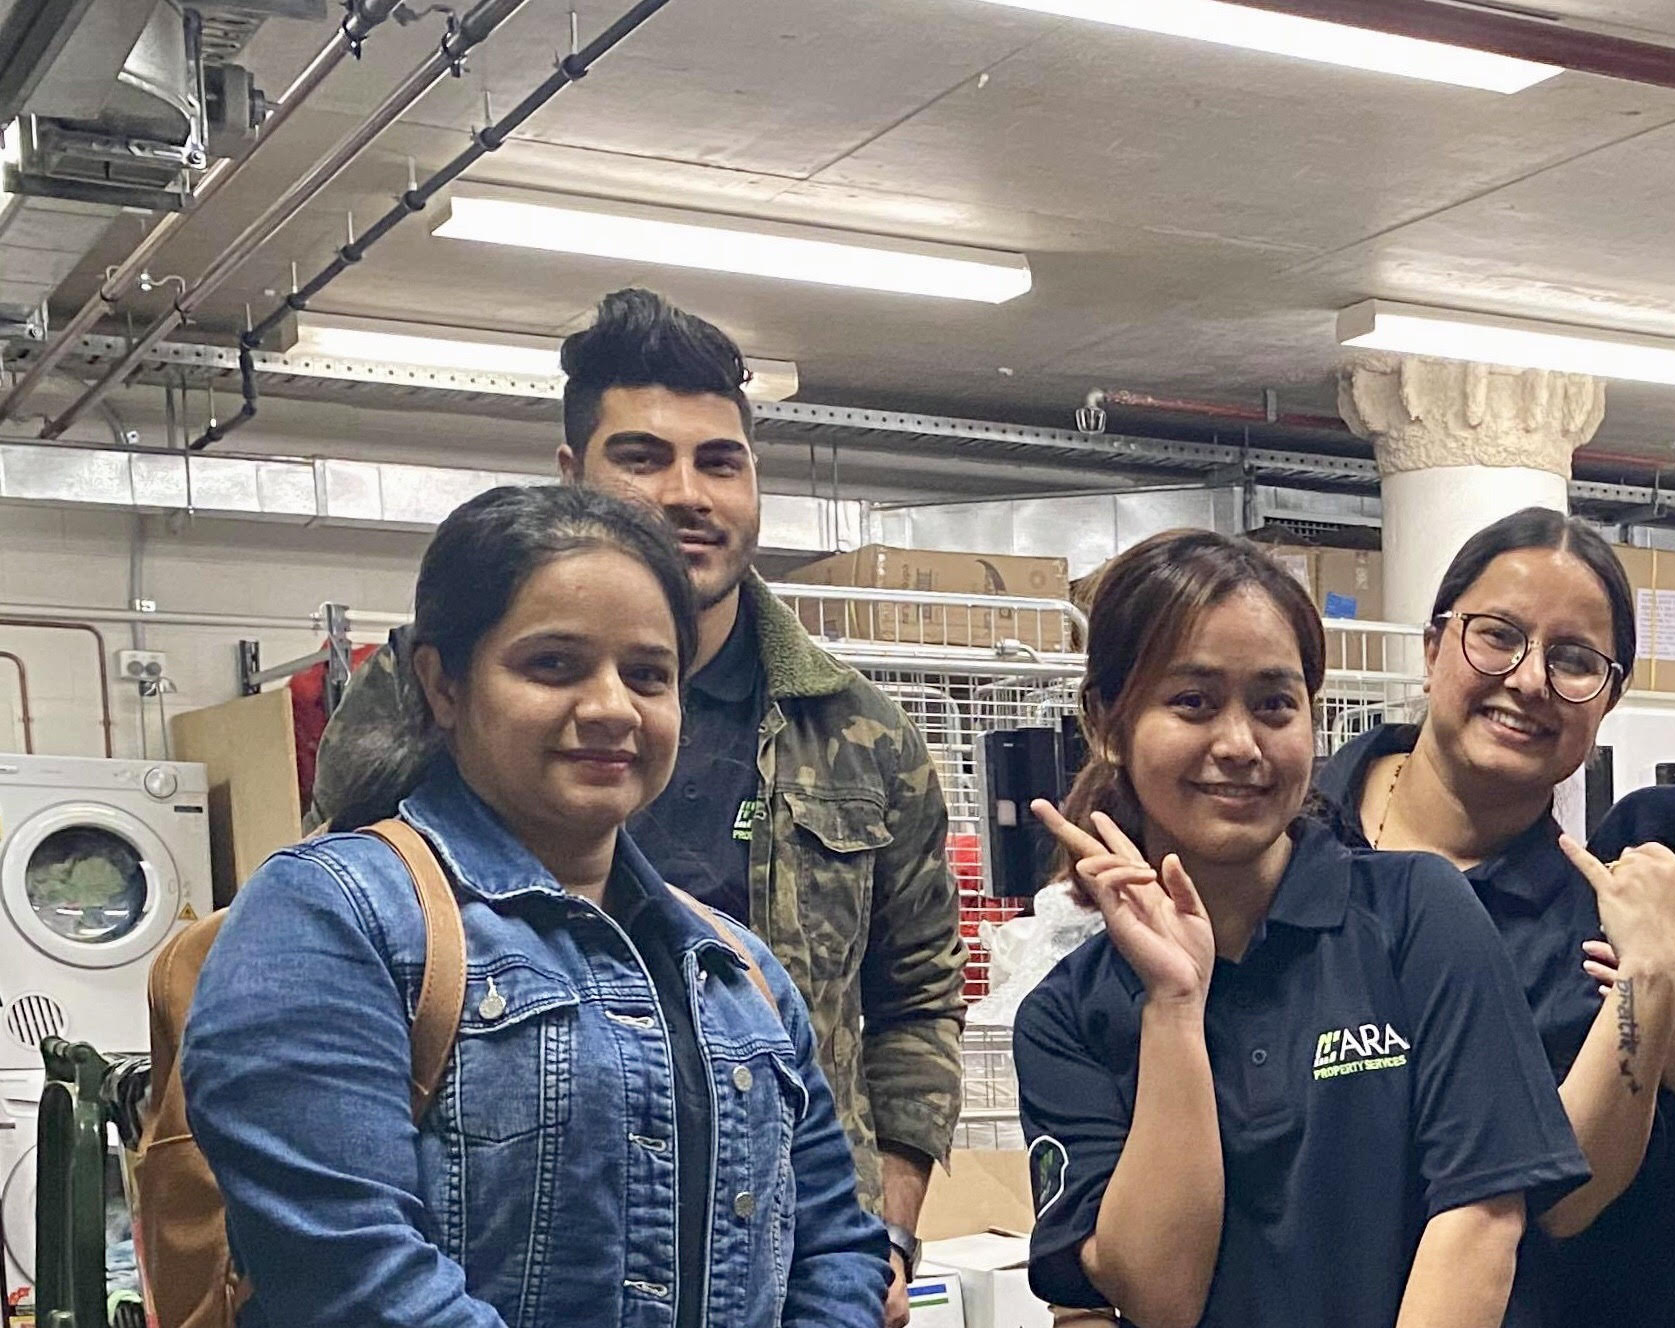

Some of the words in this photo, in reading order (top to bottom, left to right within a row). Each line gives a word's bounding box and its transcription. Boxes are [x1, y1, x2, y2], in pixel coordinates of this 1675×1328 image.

[1340, 1023, 1411, 1060] ARA
[1313, 1060, 1365, 1080] PROPERTY
[1364, 1054, 1408, 1070] SERVICES
